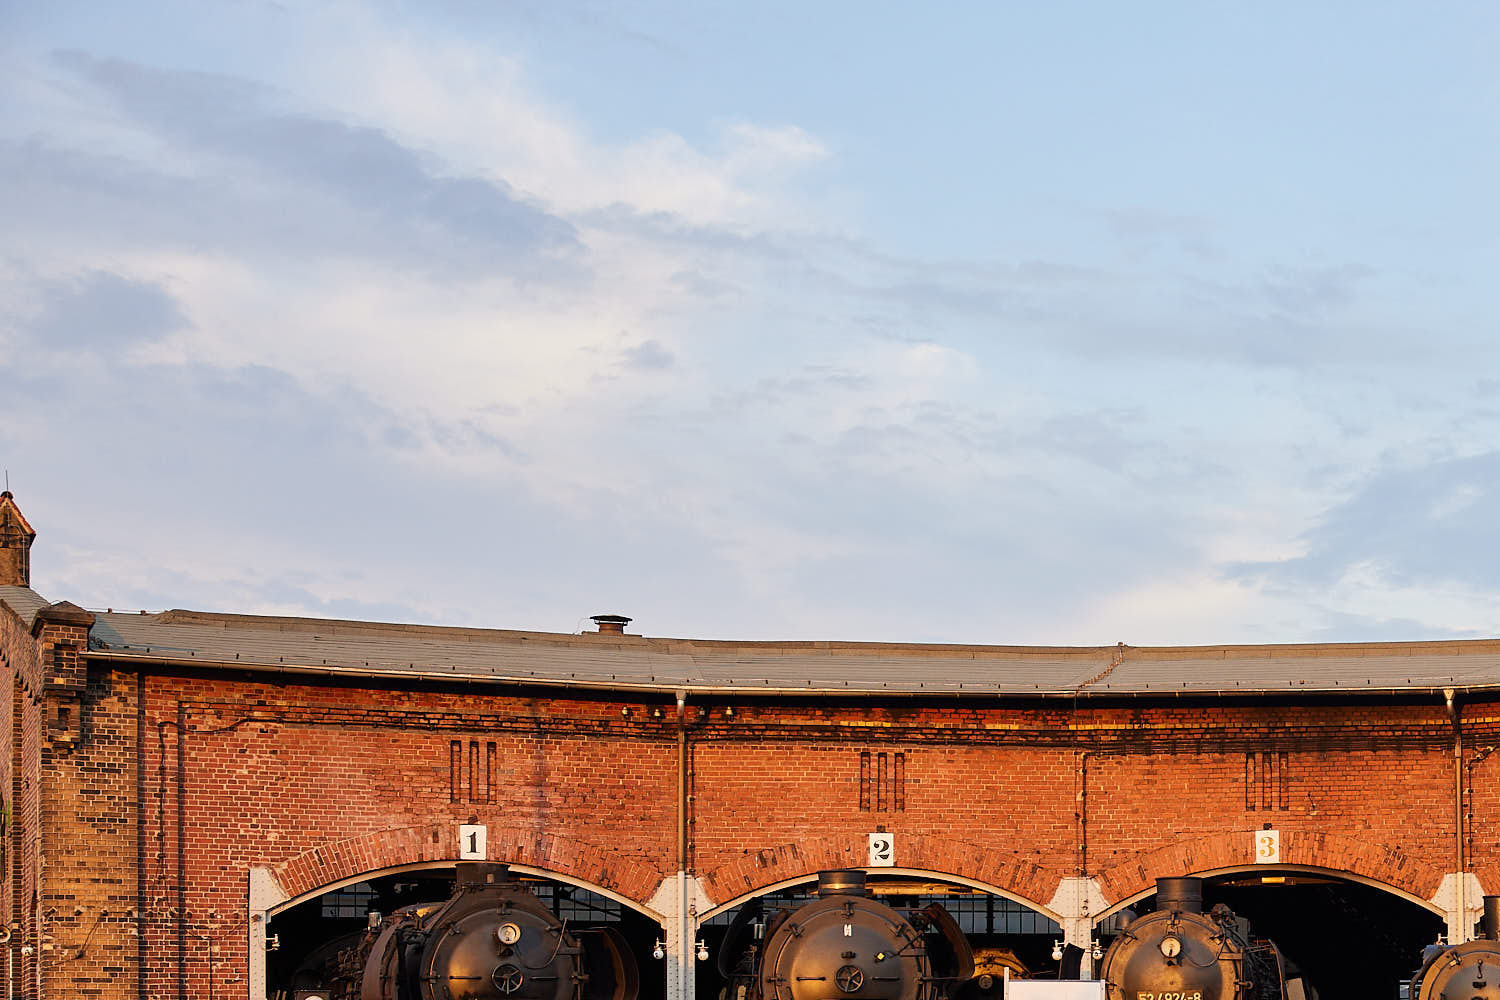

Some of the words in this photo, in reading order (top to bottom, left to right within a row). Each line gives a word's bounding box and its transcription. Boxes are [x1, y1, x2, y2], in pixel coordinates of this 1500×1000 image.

[466, 831, 481, 854] 1
[873, 839, 890, 860] 2
[1259, 836, 1274, 857] 3
